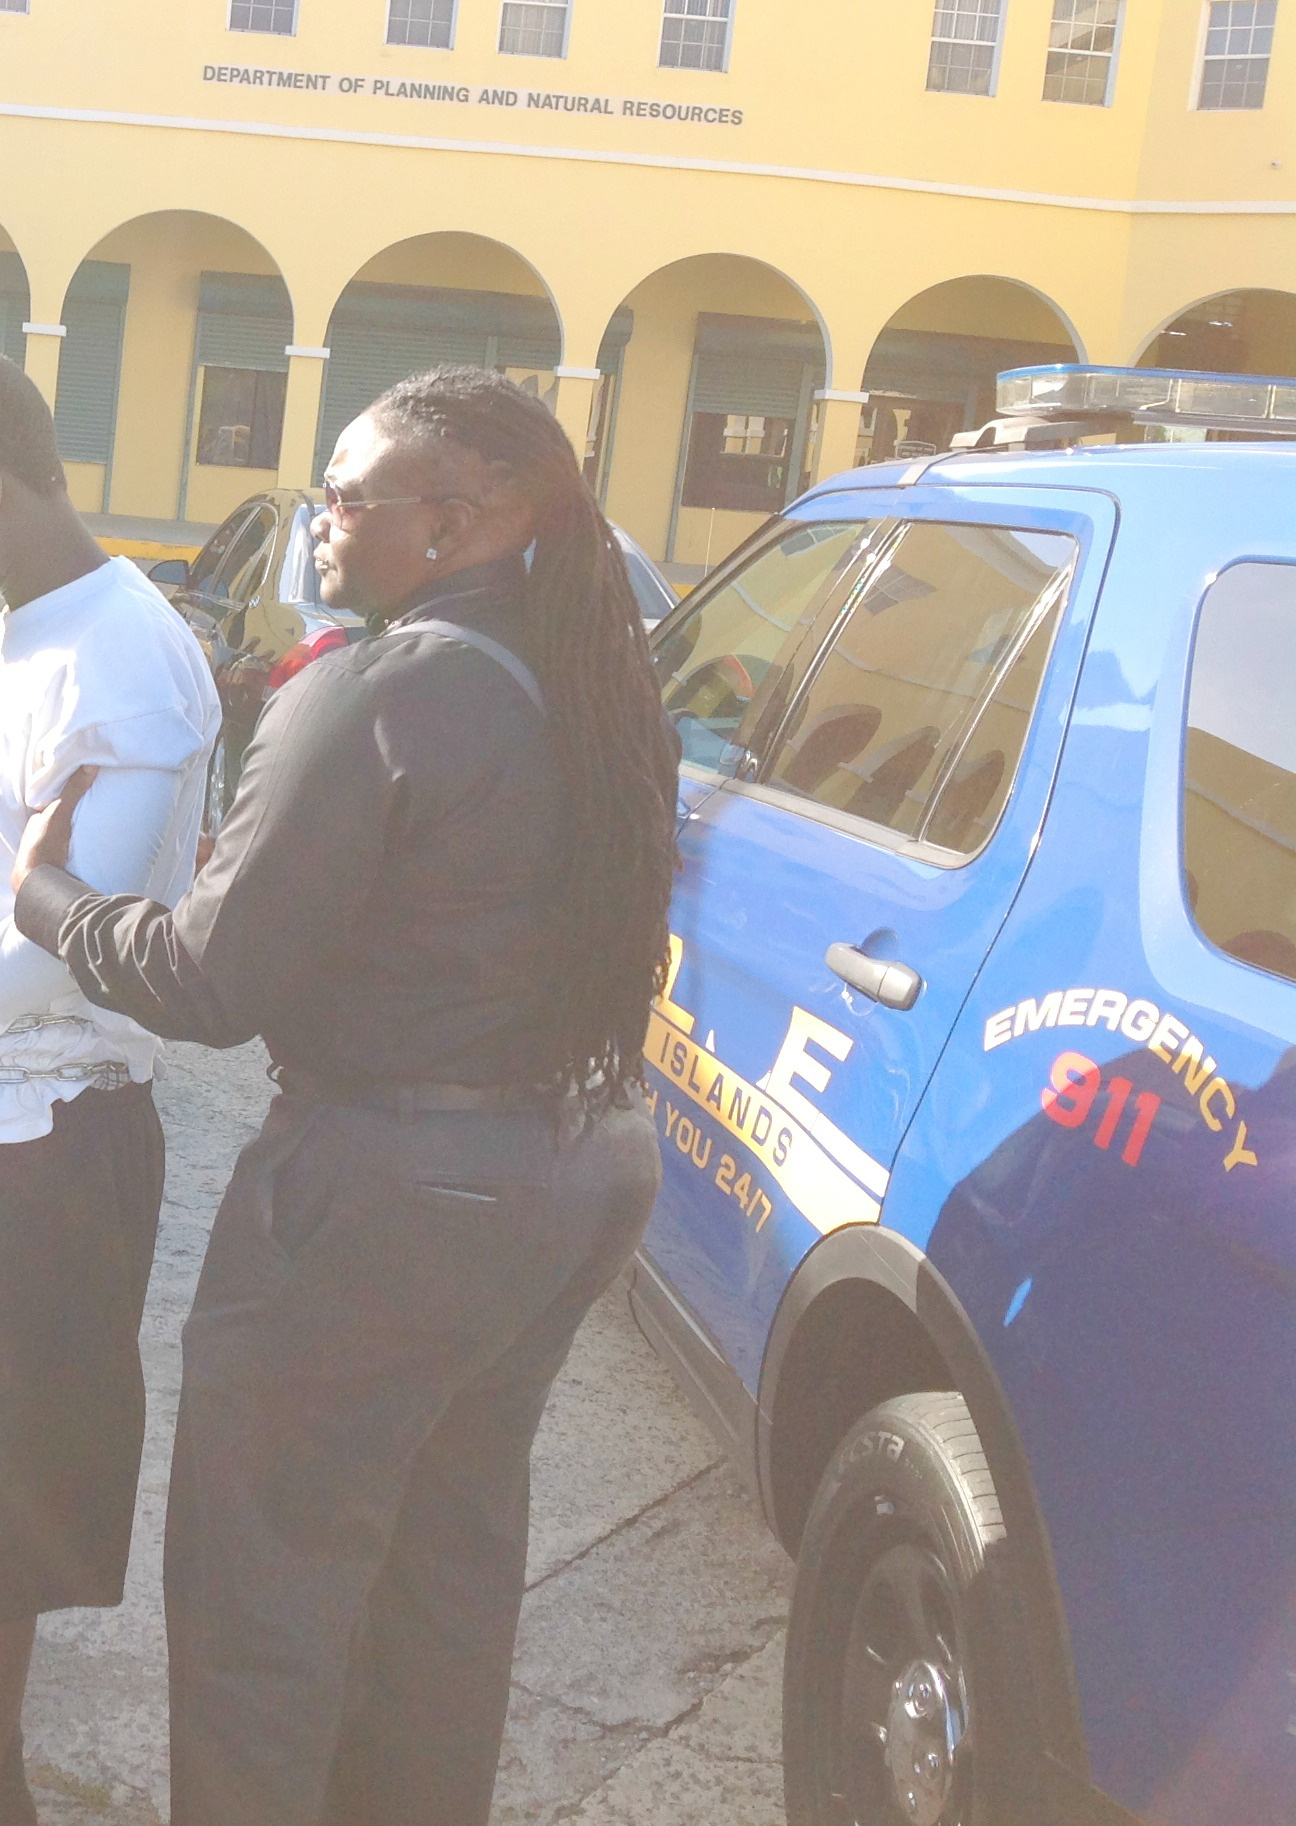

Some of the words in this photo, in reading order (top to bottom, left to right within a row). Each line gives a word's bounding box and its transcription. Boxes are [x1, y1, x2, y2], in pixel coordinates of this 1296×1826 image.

[203, 65, 331, 91] DEPARTMENT
[338, 77, 366, 94] OF
[372, 79, 470, 103] PLANNING
[478, 88, 518, 107] AND
[527, 92, 614, 115] NATURAL
[622, 100, 743, 126] RESOURCES
[660, 1031, 794, 1167] ISLANDS
[983, 988, 1258, 1172] EMERGENCY
[1041, 1051, 1161, 1167] 911
[664, 1101, 713, 1169] YOU
[715, 1154, 773, 1233] 24/7
